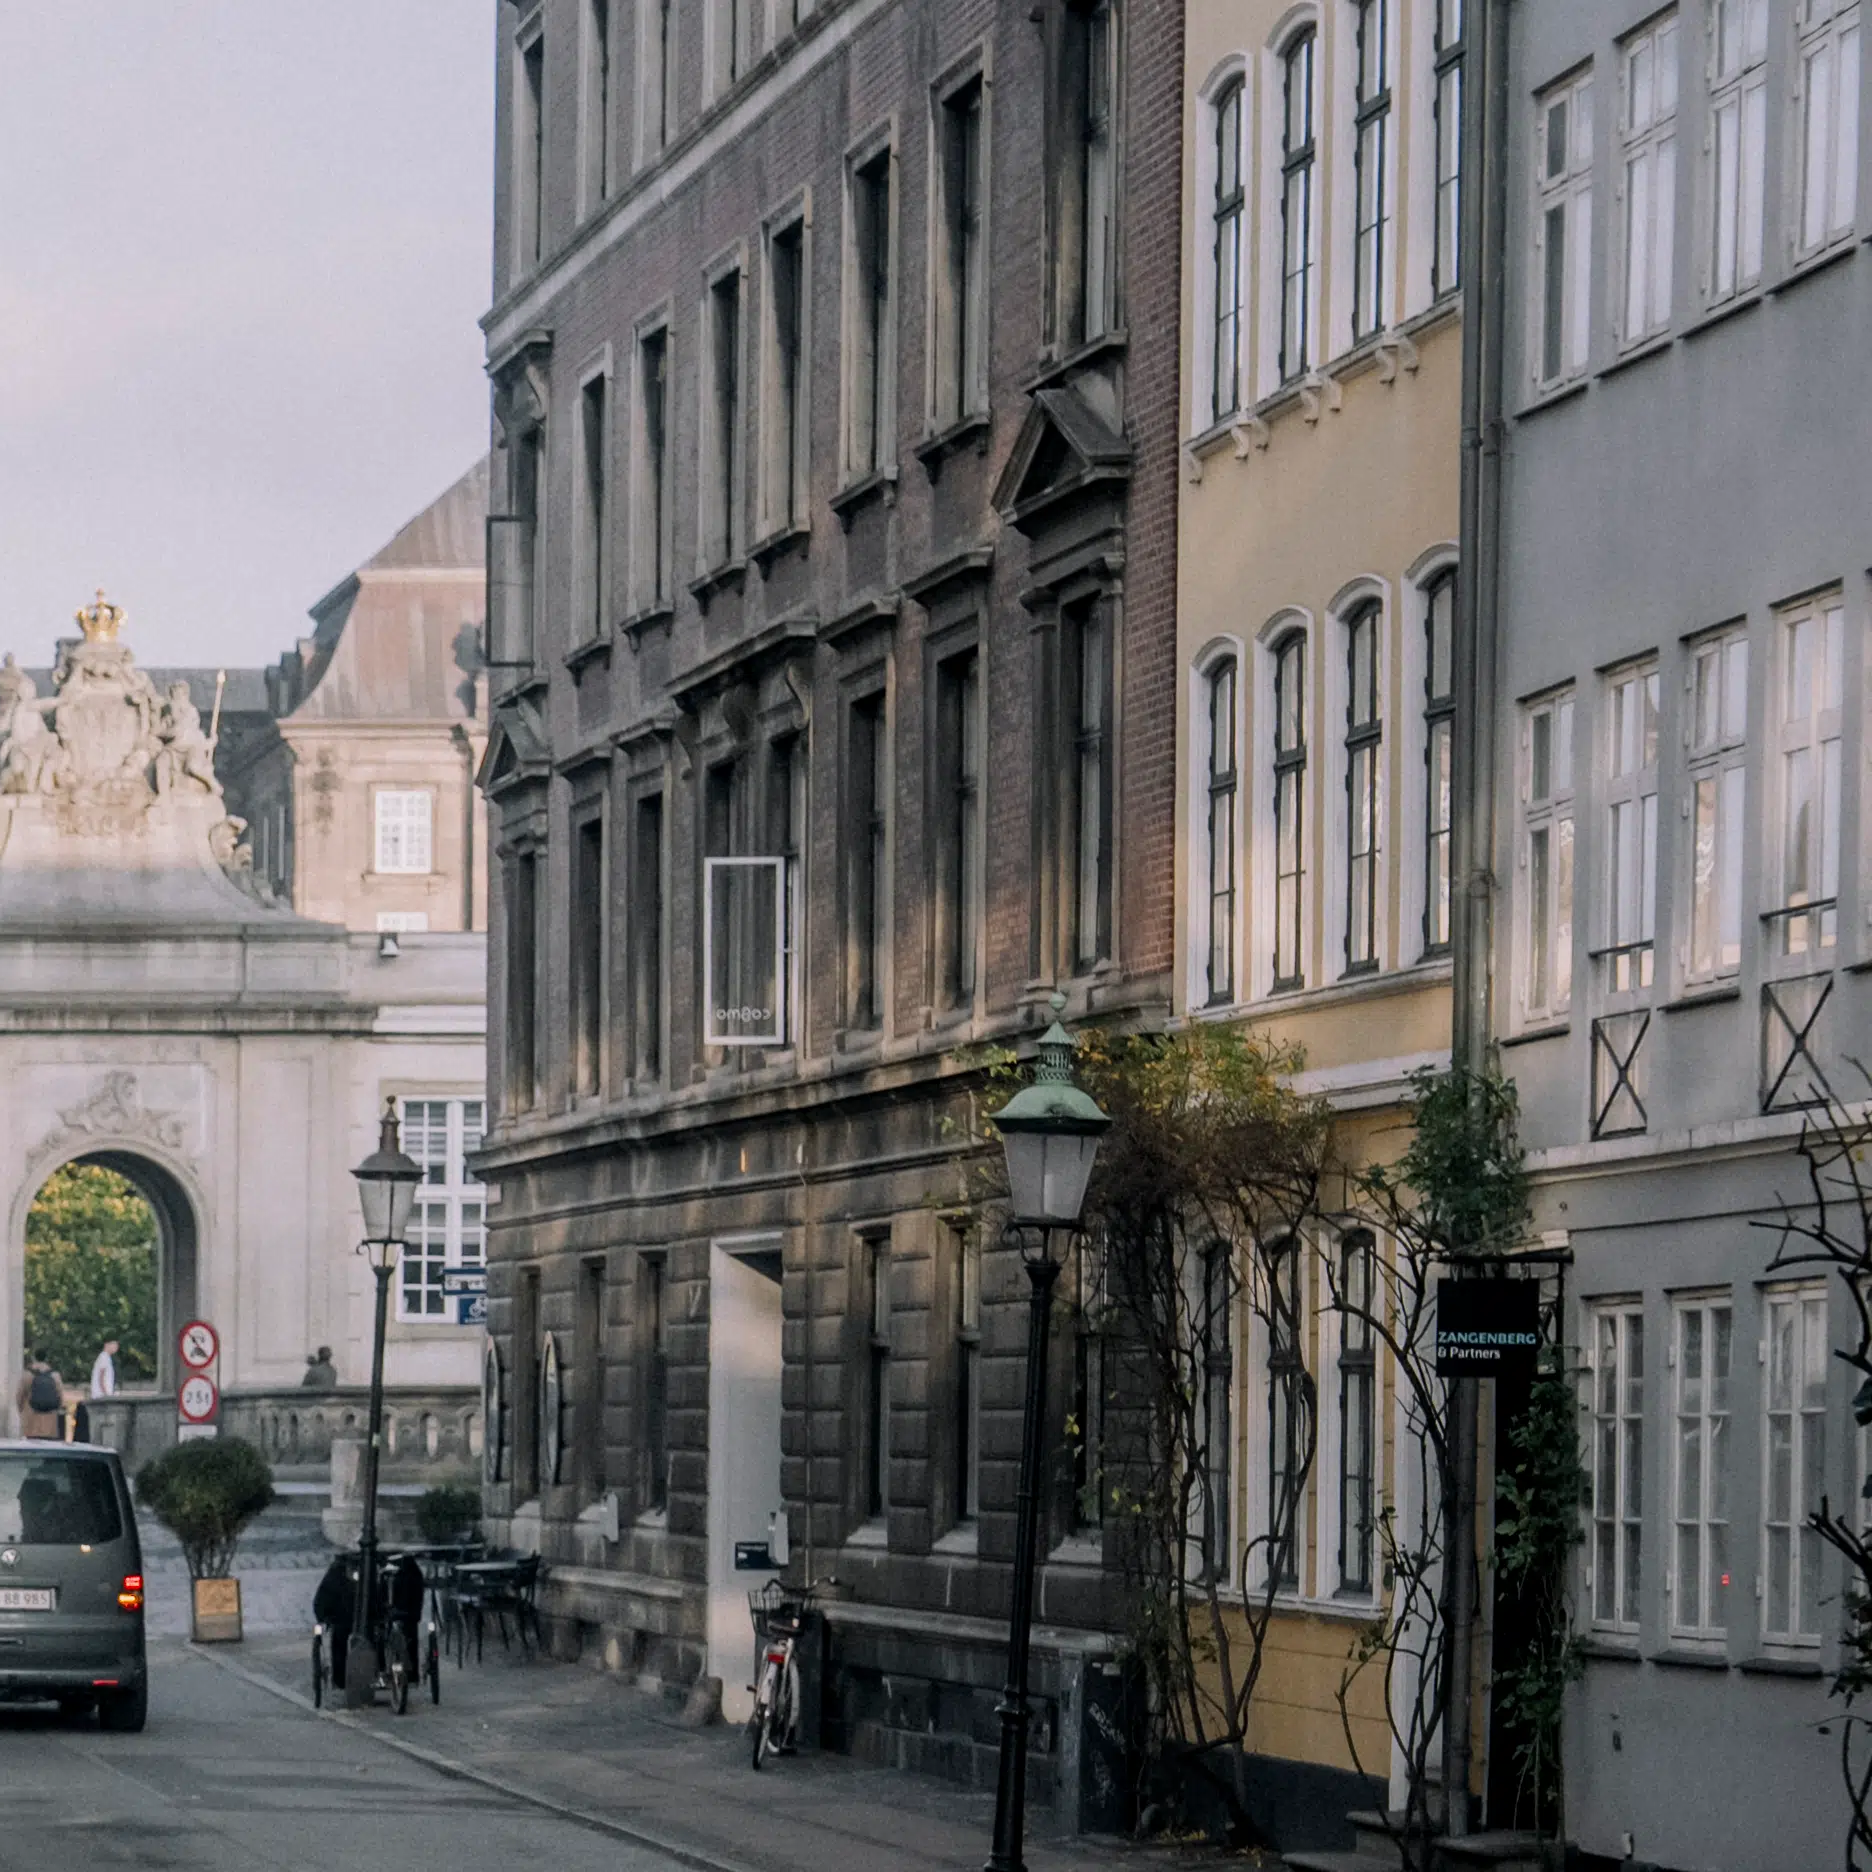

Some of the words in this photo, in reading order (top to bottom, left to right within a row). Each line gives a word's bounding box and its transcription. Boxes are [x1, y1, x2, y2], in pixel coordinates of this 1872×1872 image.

[1438, 1331, 1536, 1344] ZANGENBERG
[1438, 1346, 1447, 1358] &
[1450, 1346, 1501, 1359] Partners
